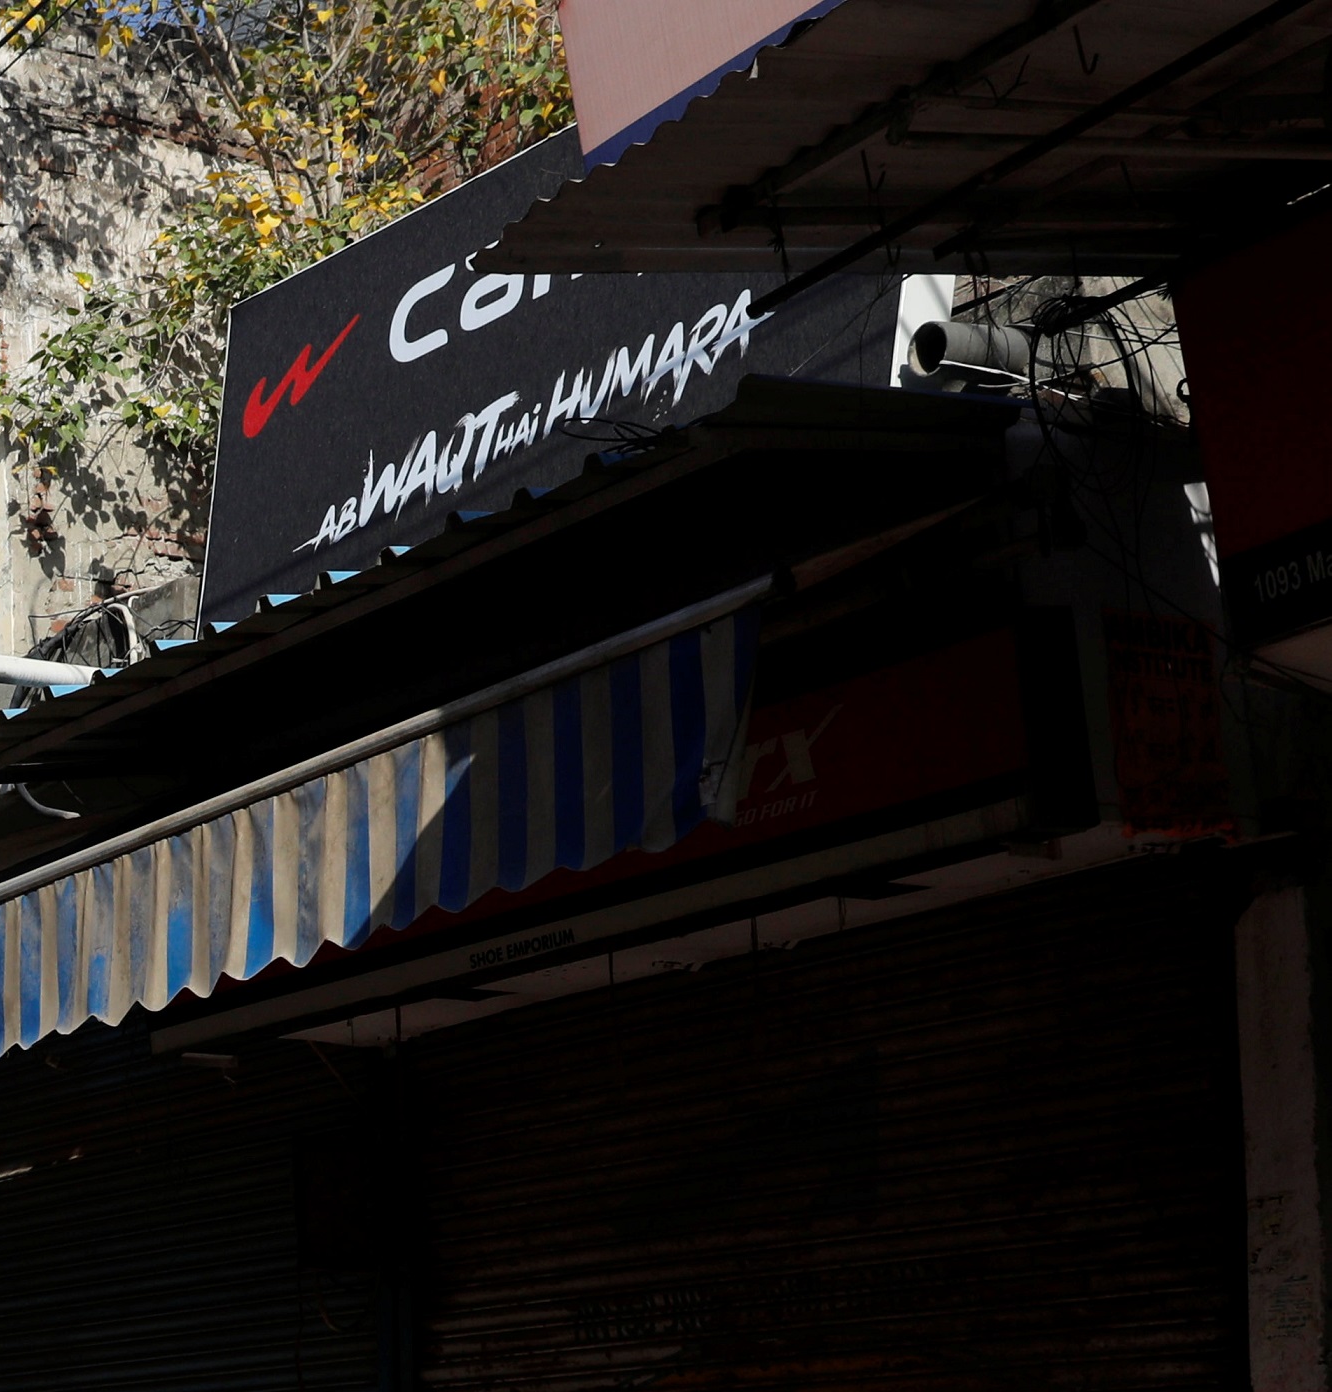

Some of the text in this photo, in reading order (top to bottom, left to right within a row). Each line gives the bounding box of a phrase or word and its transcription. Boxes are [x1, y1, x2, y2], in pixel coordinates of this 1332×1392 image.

[543, 289, 775, 439] HUMARA
[1253, 561, 1302, 604] 1093
[759, 795, 798, 822] FOR
[800, 787, 820, 809] IT
[470, 929, 575, 969] SHOE EMPORIUM
